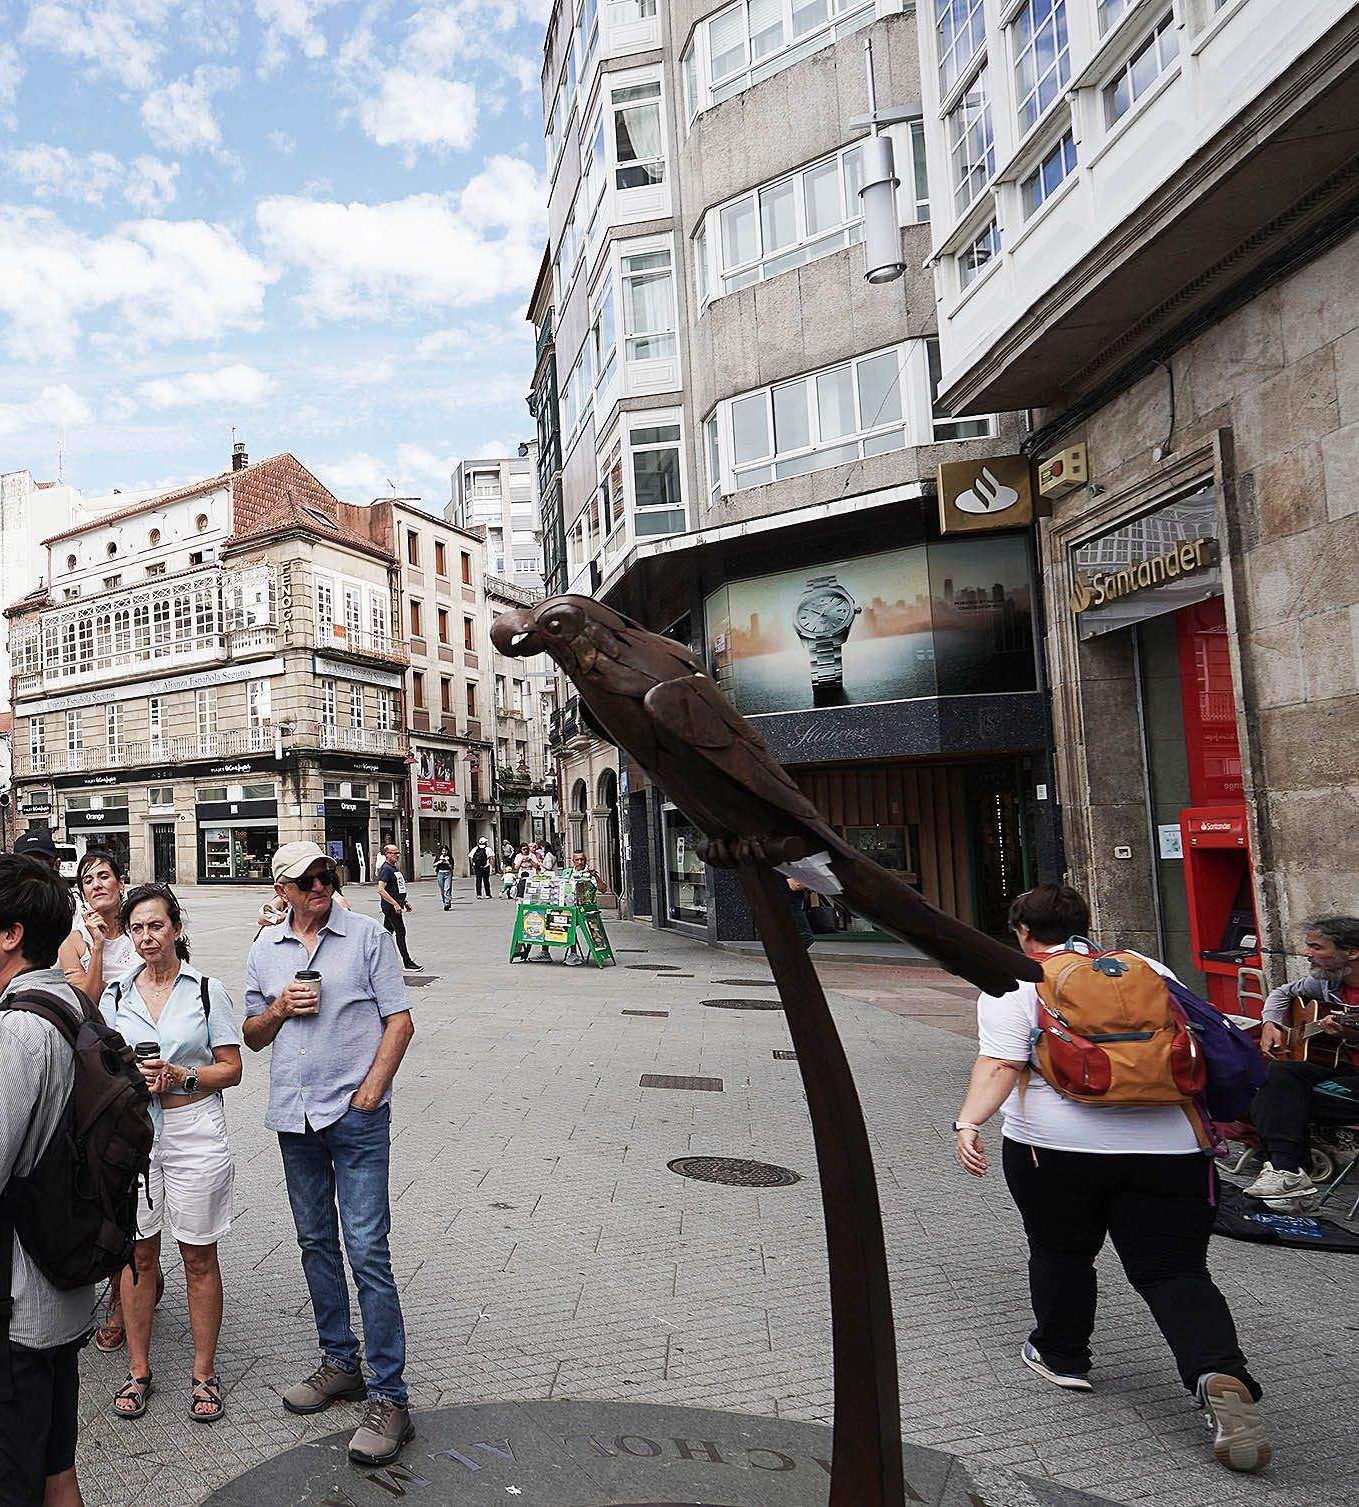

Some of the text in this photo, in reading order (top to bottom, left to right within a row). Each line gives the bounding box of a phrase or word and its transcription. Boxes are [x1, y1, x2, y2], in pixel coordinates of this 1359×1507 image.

[1093, 537, 1204, 605] Santander
[222, 669, 251, 680] Seguros
[341, 802, 357, 811] Orange
[85, 812, 105, 821] Orange
[1206, 821, 1231, 831] Santander
